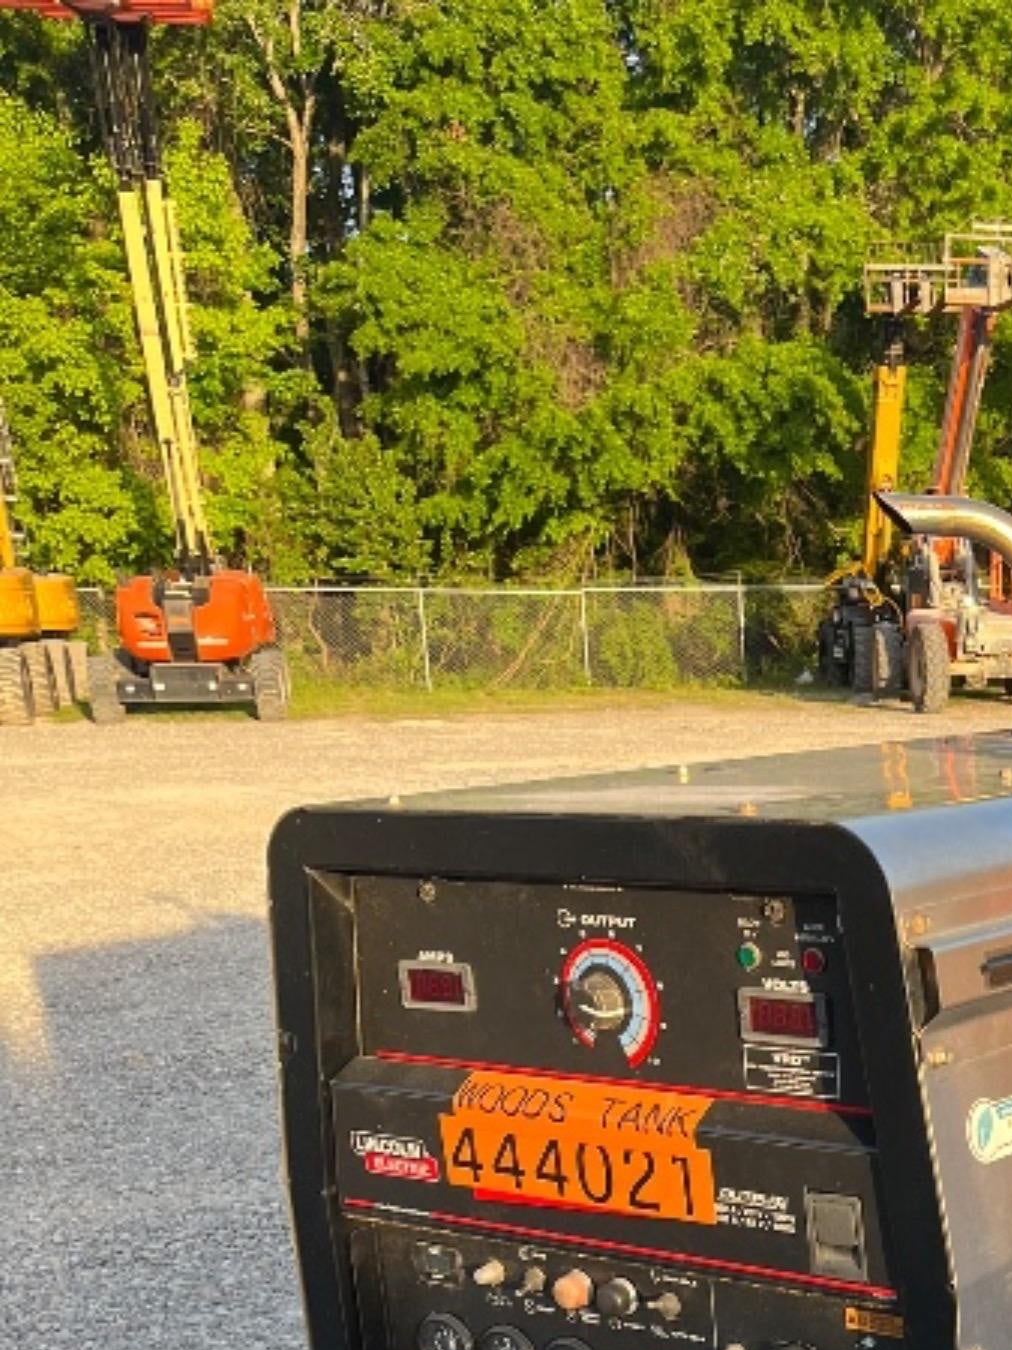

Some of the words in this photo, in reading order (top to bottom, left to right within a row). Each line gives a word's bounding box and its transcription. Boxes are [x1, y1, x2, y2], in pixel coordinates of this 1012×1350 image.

[580, 913, 637, 929] OUTPUT
[457, 1078, 575, 1124] WOODS
[598, 1096, 698, 1139] TANK
[451, 1126, 695, 1216] 444021
